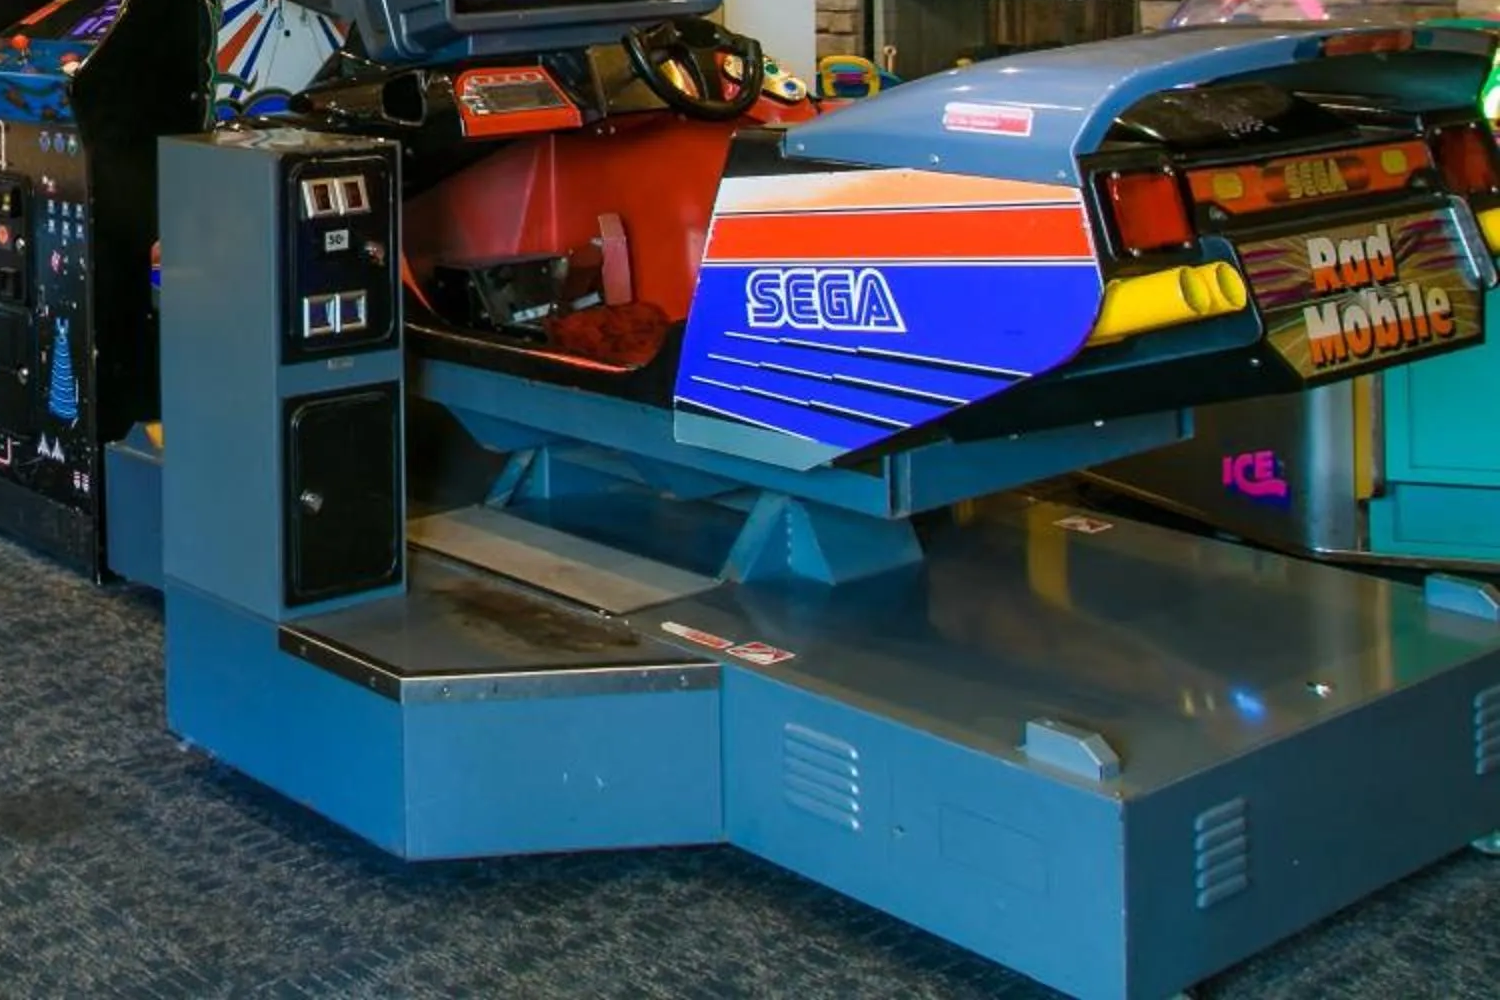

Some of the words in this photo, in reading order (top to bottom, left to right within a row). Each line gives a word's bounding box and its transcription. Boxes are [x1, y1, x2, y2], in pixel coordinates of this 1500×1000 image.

[1284, 157, 1349, 199] SEGA
[1306, 222, 1397, 292] Rad
[745, 267, 907, 333] SEGA
[1303, 282, 1454, 366] Mobile
[1222, 450, 1287, 497] ICE
